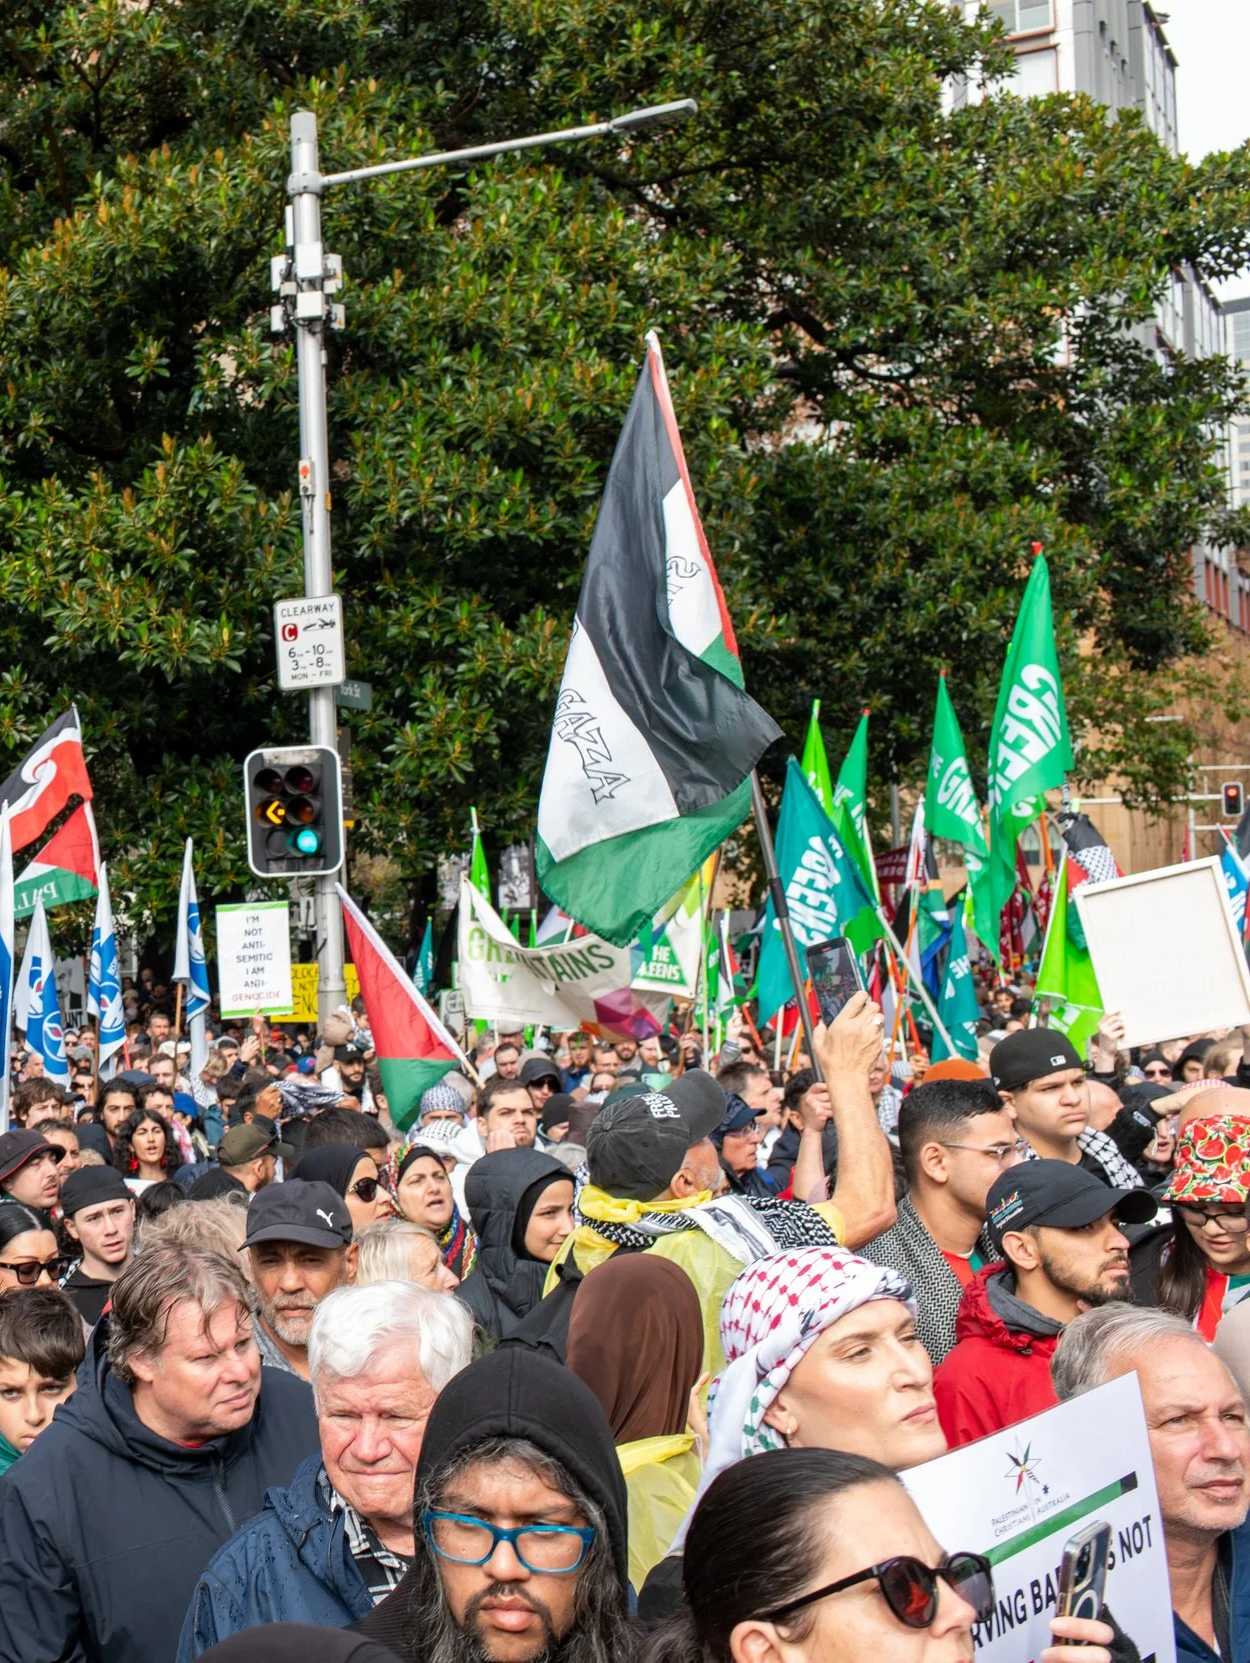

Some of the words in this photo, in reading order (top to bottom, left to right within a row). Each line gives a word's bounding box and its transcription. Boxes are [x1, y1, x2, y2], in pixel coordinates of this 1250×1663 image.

[280, 602, 335, 618] CLEARWAY
[291, 673, 309, 681] MON
[319, 670, 333, 678] FRI
[553, 688, 631, 805] GAZA
[245, 916, 260, 924] I'M
[244, 928, 262, 937] NOT
[242, 941, 266, 950] ANTI-
[236, 953, 273, 963] SEMITIC
[652, 944, 671, 963] HE
[251, 967, 265, 975] AM
[243, 979, 267, 988] ANTI-
[231, 991, 281, 1001] GENOCIDE
[1036, 1492, 1071, 1515] AUSTRALIA
[993, 1514, 1031, 1538] CHRISTIANS
[970, 1588, 1028, 1649] RVING
[1118, 1514, 1152, 1563] NOT
